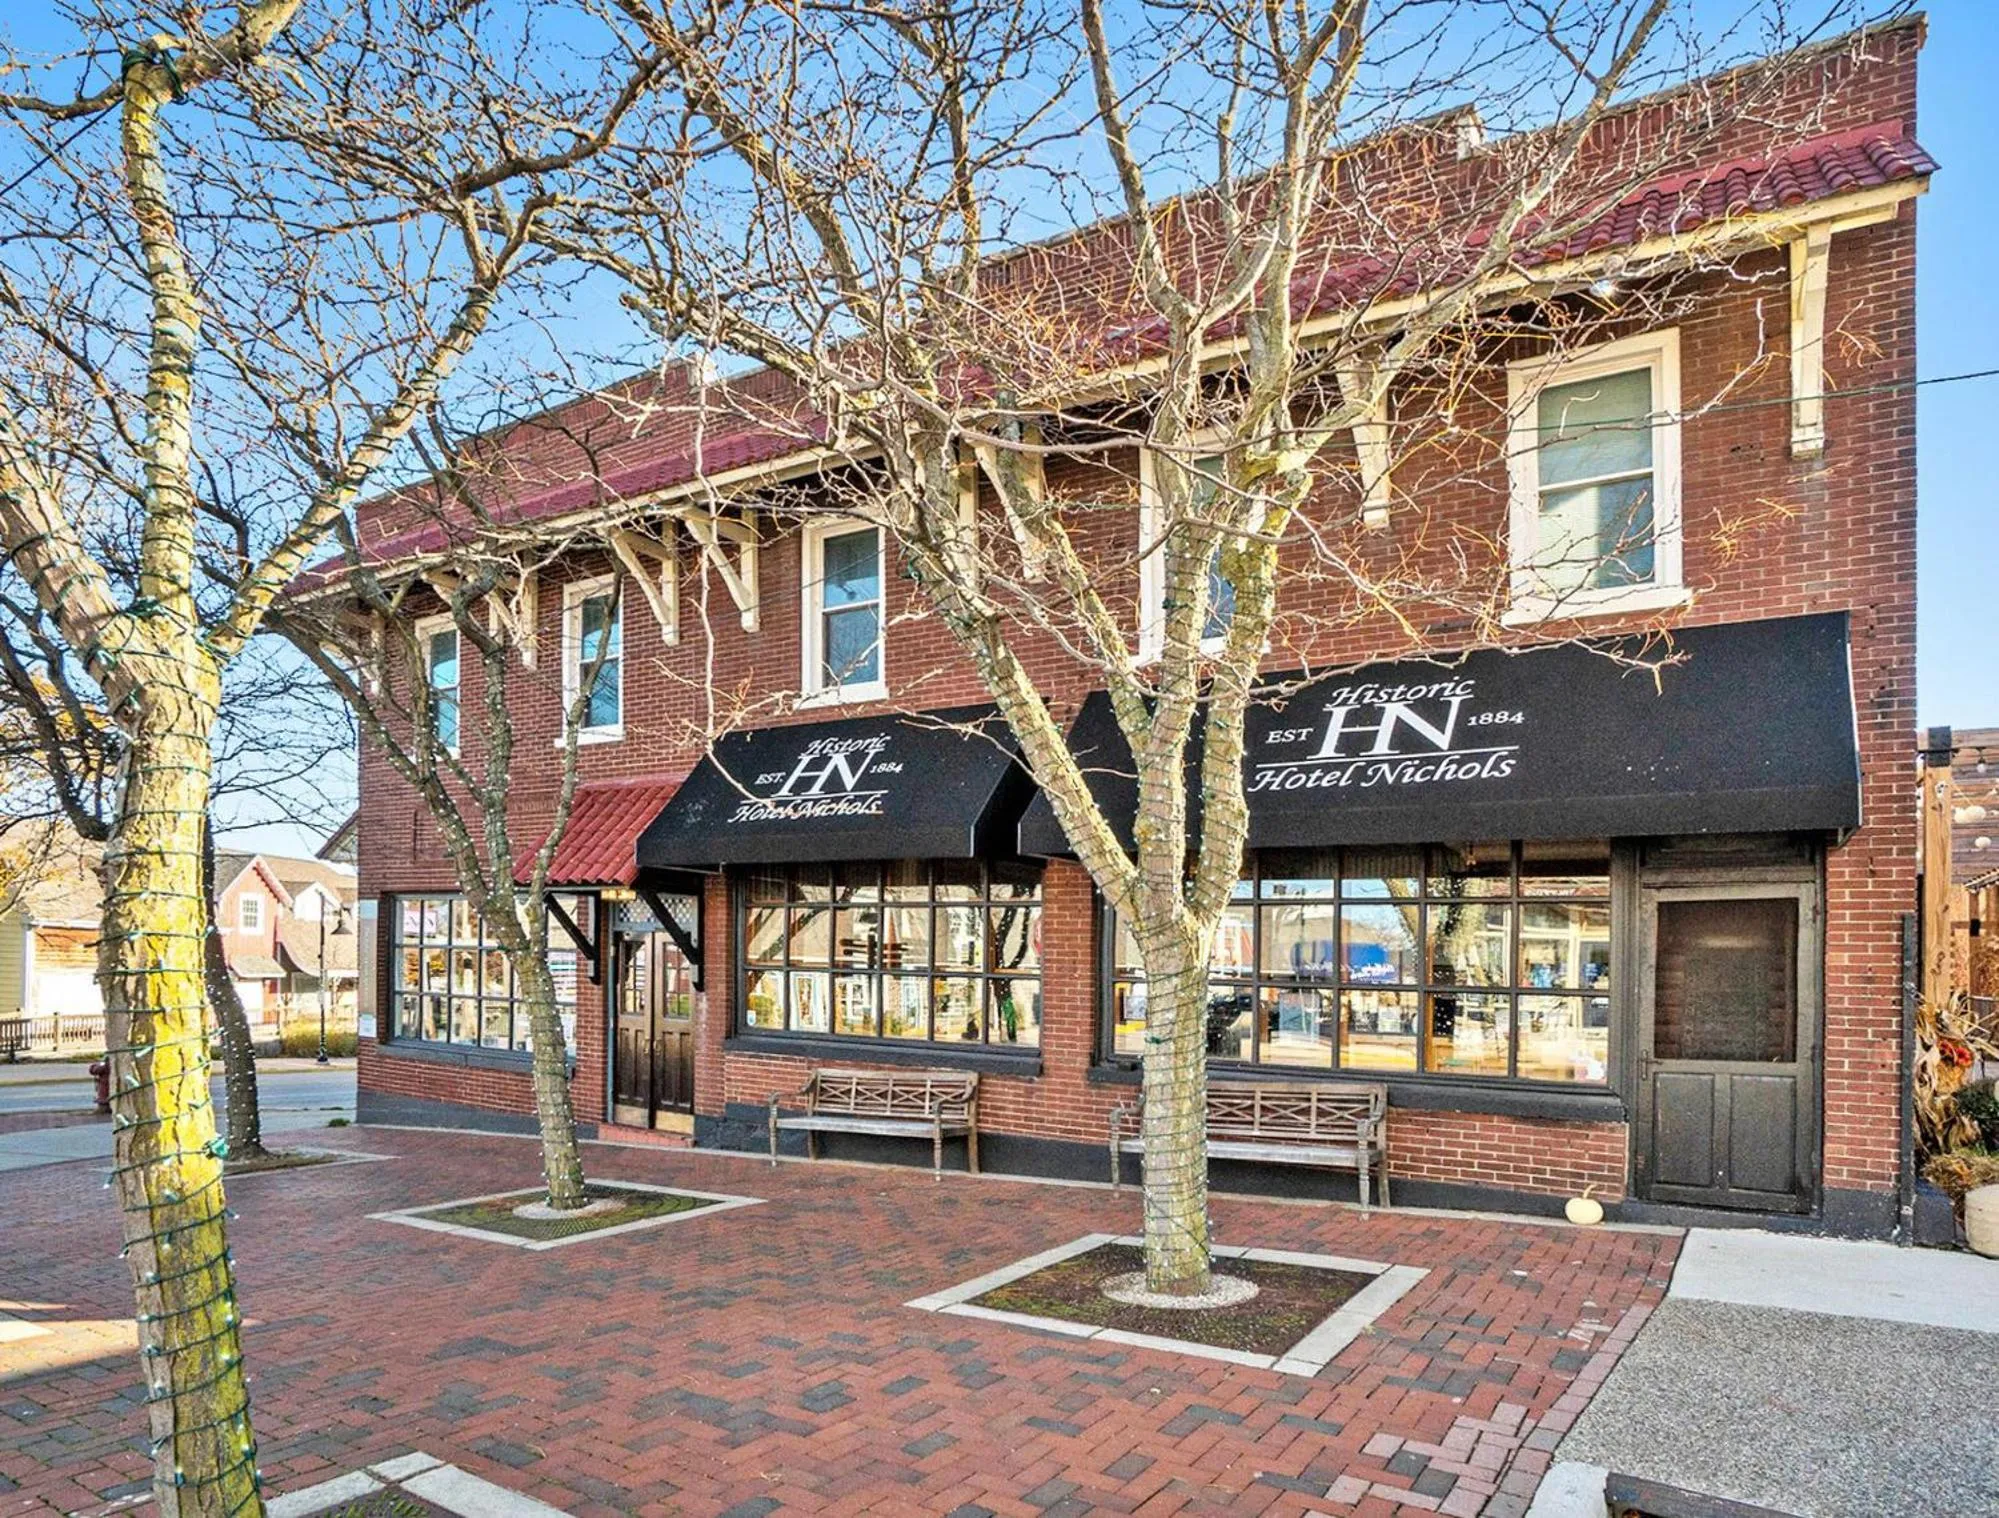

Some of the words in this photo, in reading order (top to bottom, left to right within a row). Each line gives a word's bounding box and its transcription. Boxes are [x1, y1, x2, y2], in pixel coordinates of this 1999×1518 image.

[1326, 676, 1475, 708] Historic
[1306, 696, 1474, 760] HN
[1467, 711, 1525, 726] 1884
[801, 733, 891, 756] Historic
[1266, 728, 1313, 744] EST
[771, 748, 884, 797] HN
[870, 763, 904, 773] 1884
[1247, 762, 1367, 792] Hotel
[1361, 752, 1516, 788] Nichols
[727, 800, 801, 823] Hotel
[791, 794, 882, 819] Nichols
